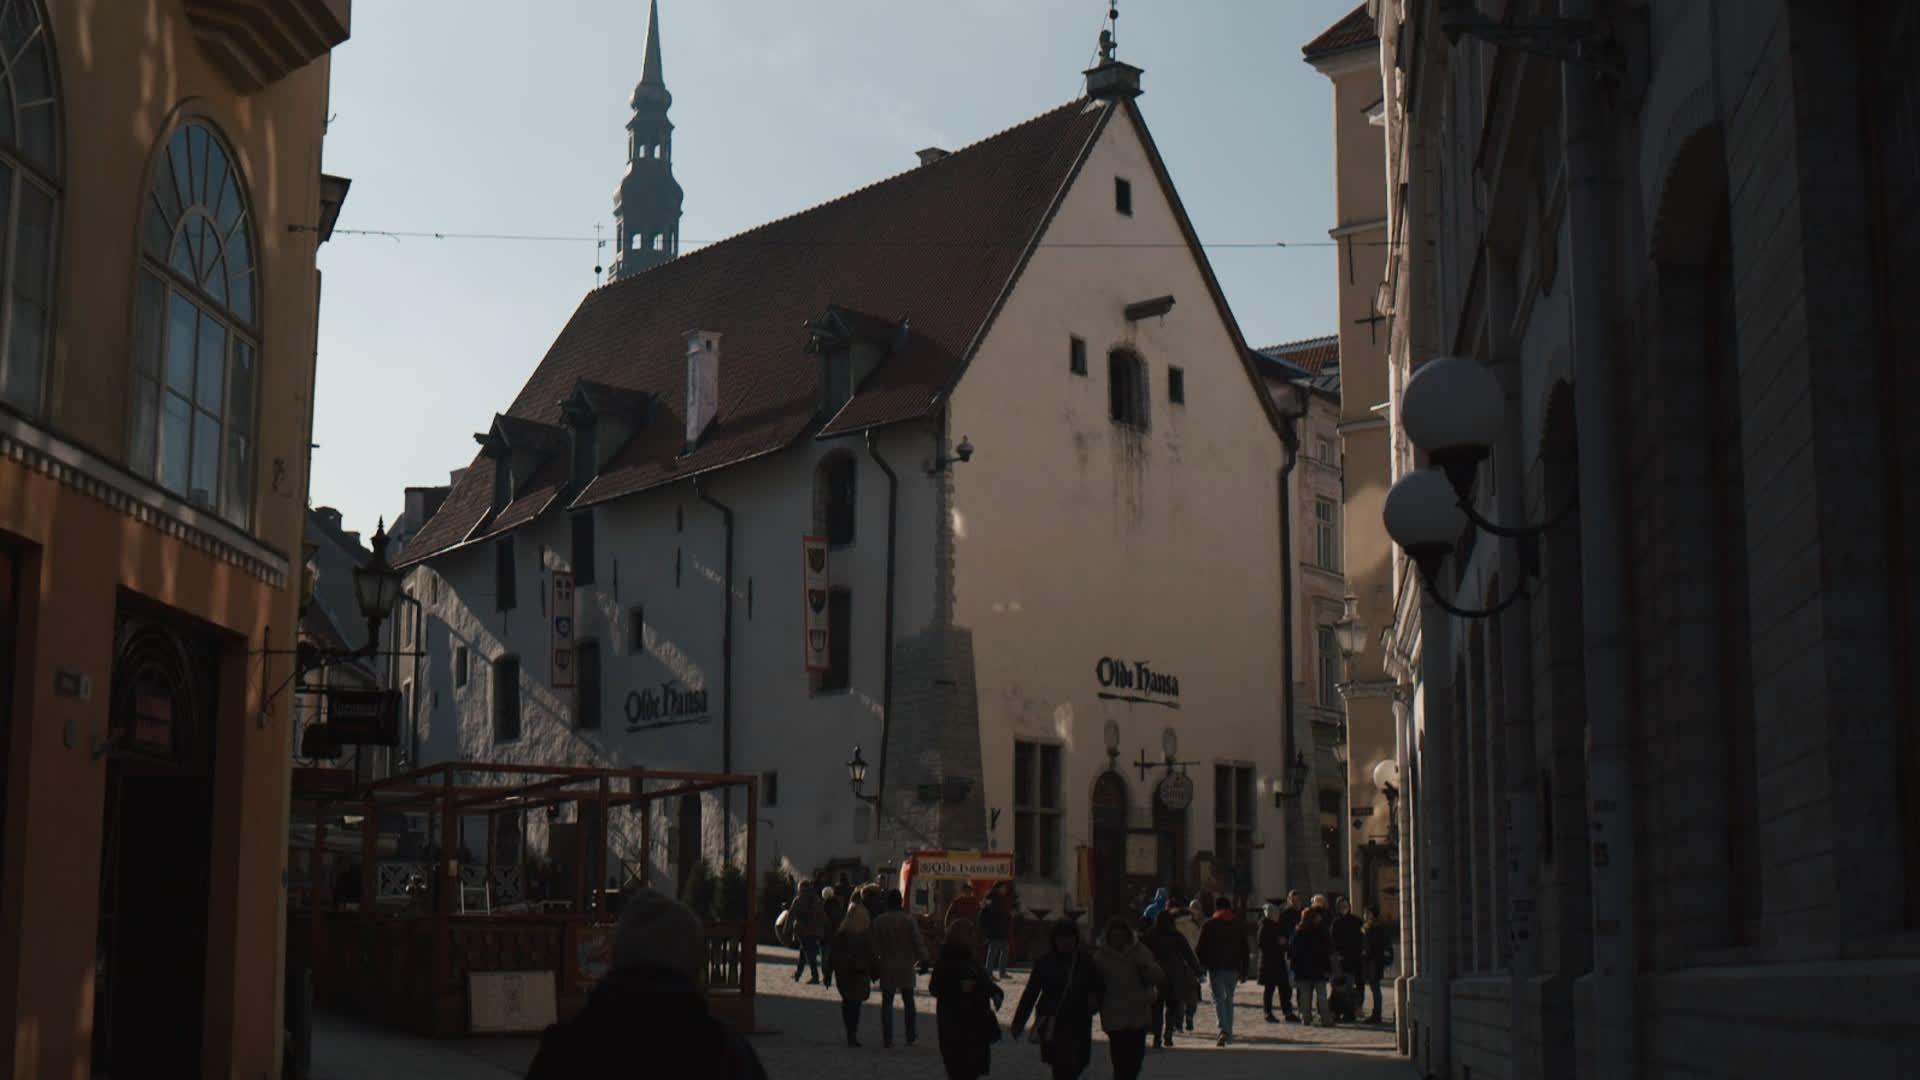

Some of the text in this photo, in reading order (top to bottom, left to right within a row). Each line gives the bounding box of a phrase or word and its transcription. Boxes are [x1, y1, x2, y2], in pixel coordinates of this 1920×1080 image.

[1096, 657, 1179, 696] Olde Hansa
[624, 680, 707, 723] Olde Hansa
